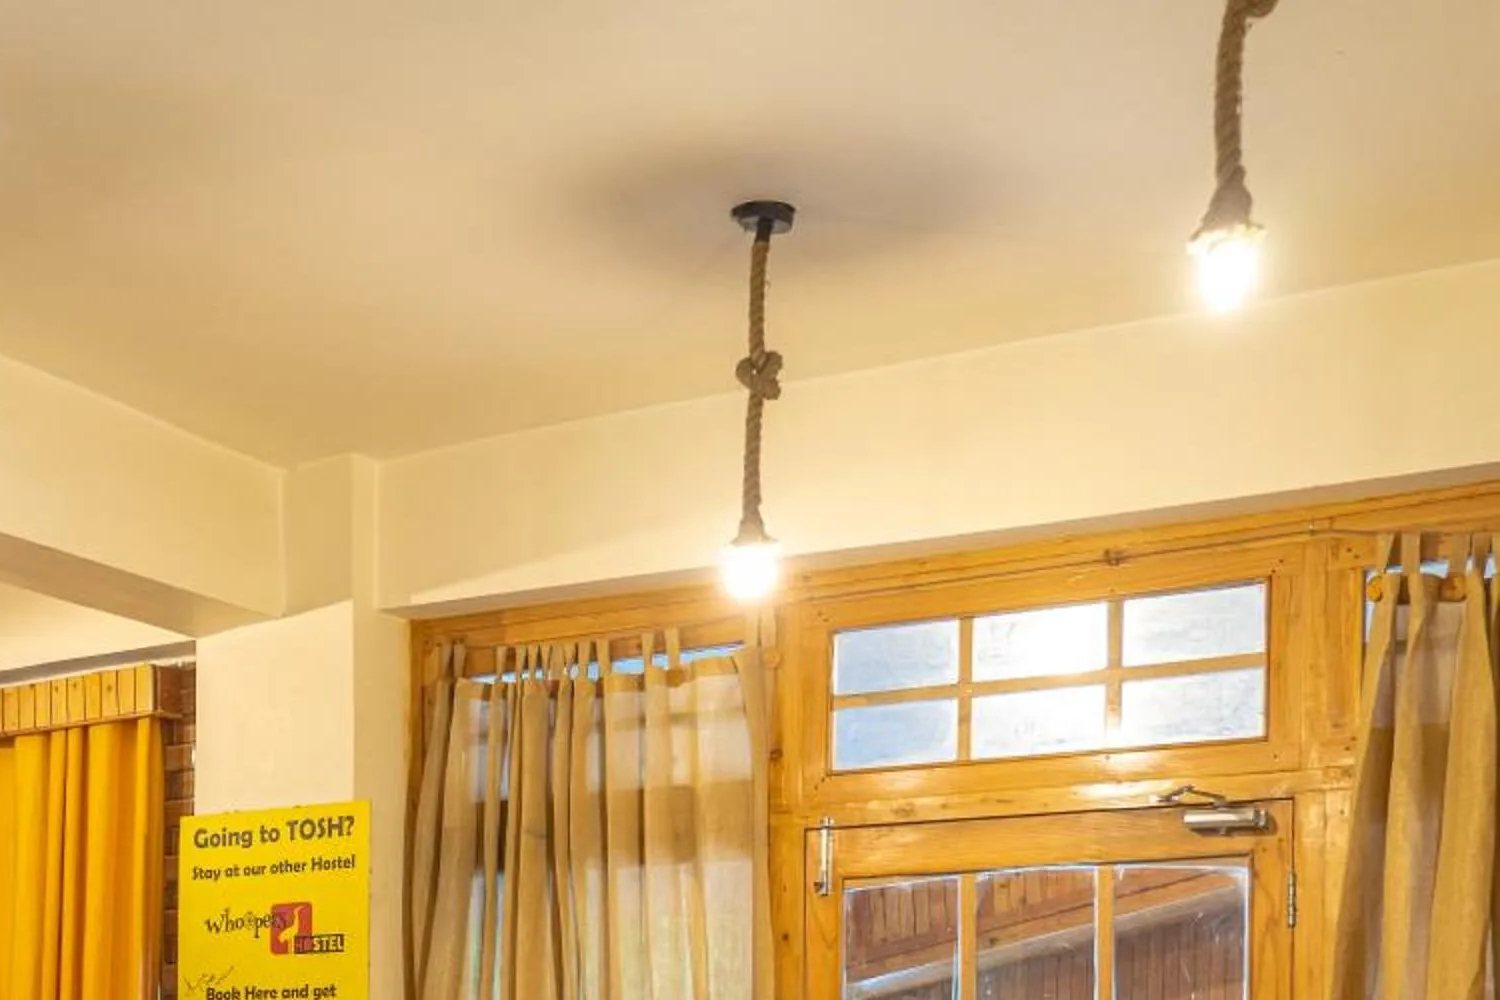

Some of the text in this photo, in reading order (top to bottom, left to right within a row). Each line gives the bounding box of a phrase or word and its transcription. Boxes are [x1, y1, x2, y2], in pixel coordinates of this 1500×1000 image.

[193, 815, 355, 849] Going to TOSH?
[192, 853, 357, 882] Stay at our other Hostel
[205, 983, 338, 1000] Book Here and get
